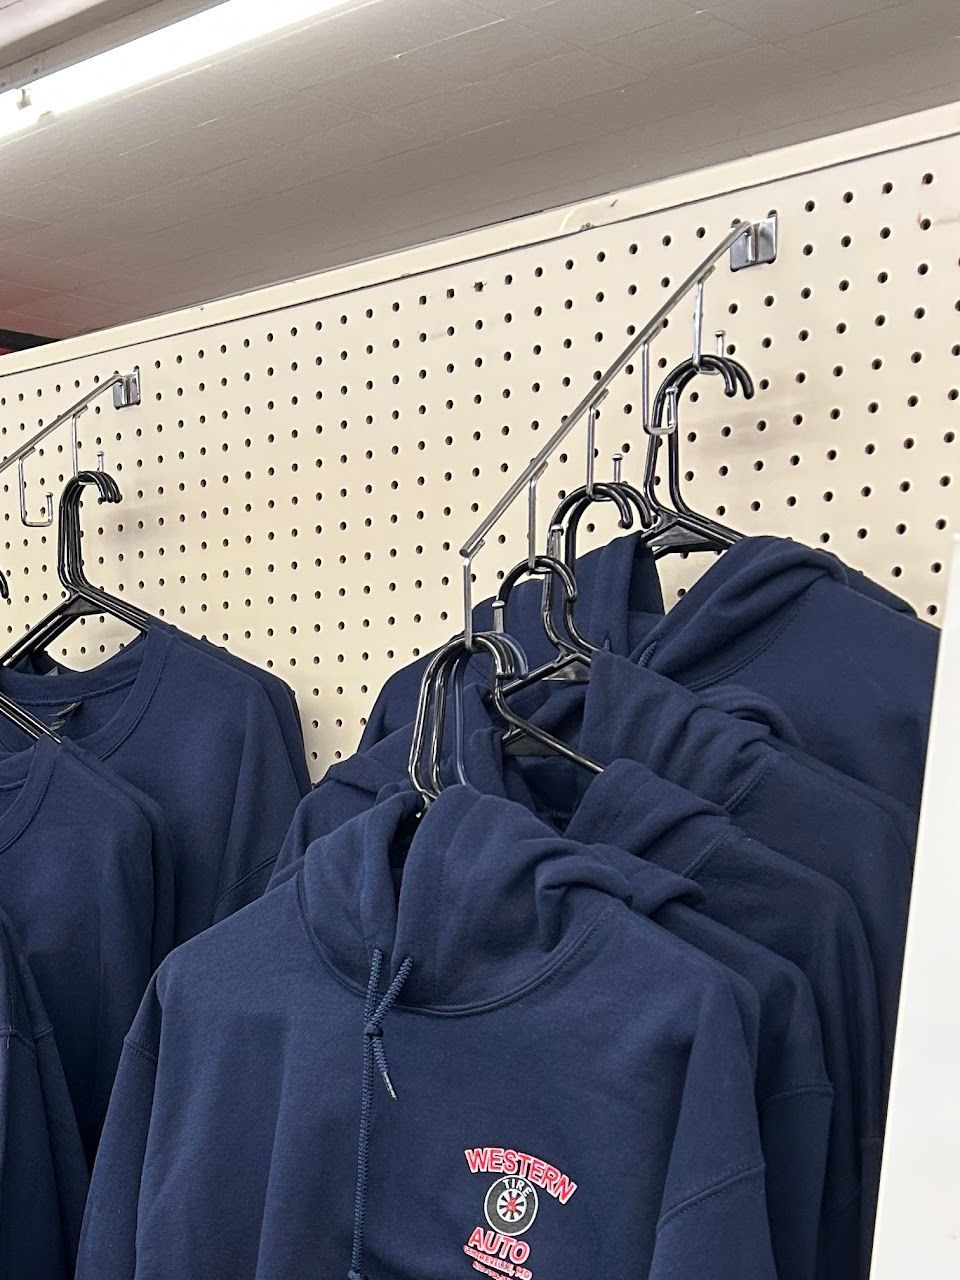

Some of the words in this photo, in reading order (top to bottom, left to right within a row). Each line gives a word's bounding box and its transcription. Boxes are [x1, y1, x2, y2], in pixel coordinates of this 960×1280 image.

[464, 1147, 578, 1205] WESTERN
[502, 1178, 533, 1198] TIRE
[468, 1227, 531, 1265] AUTO
